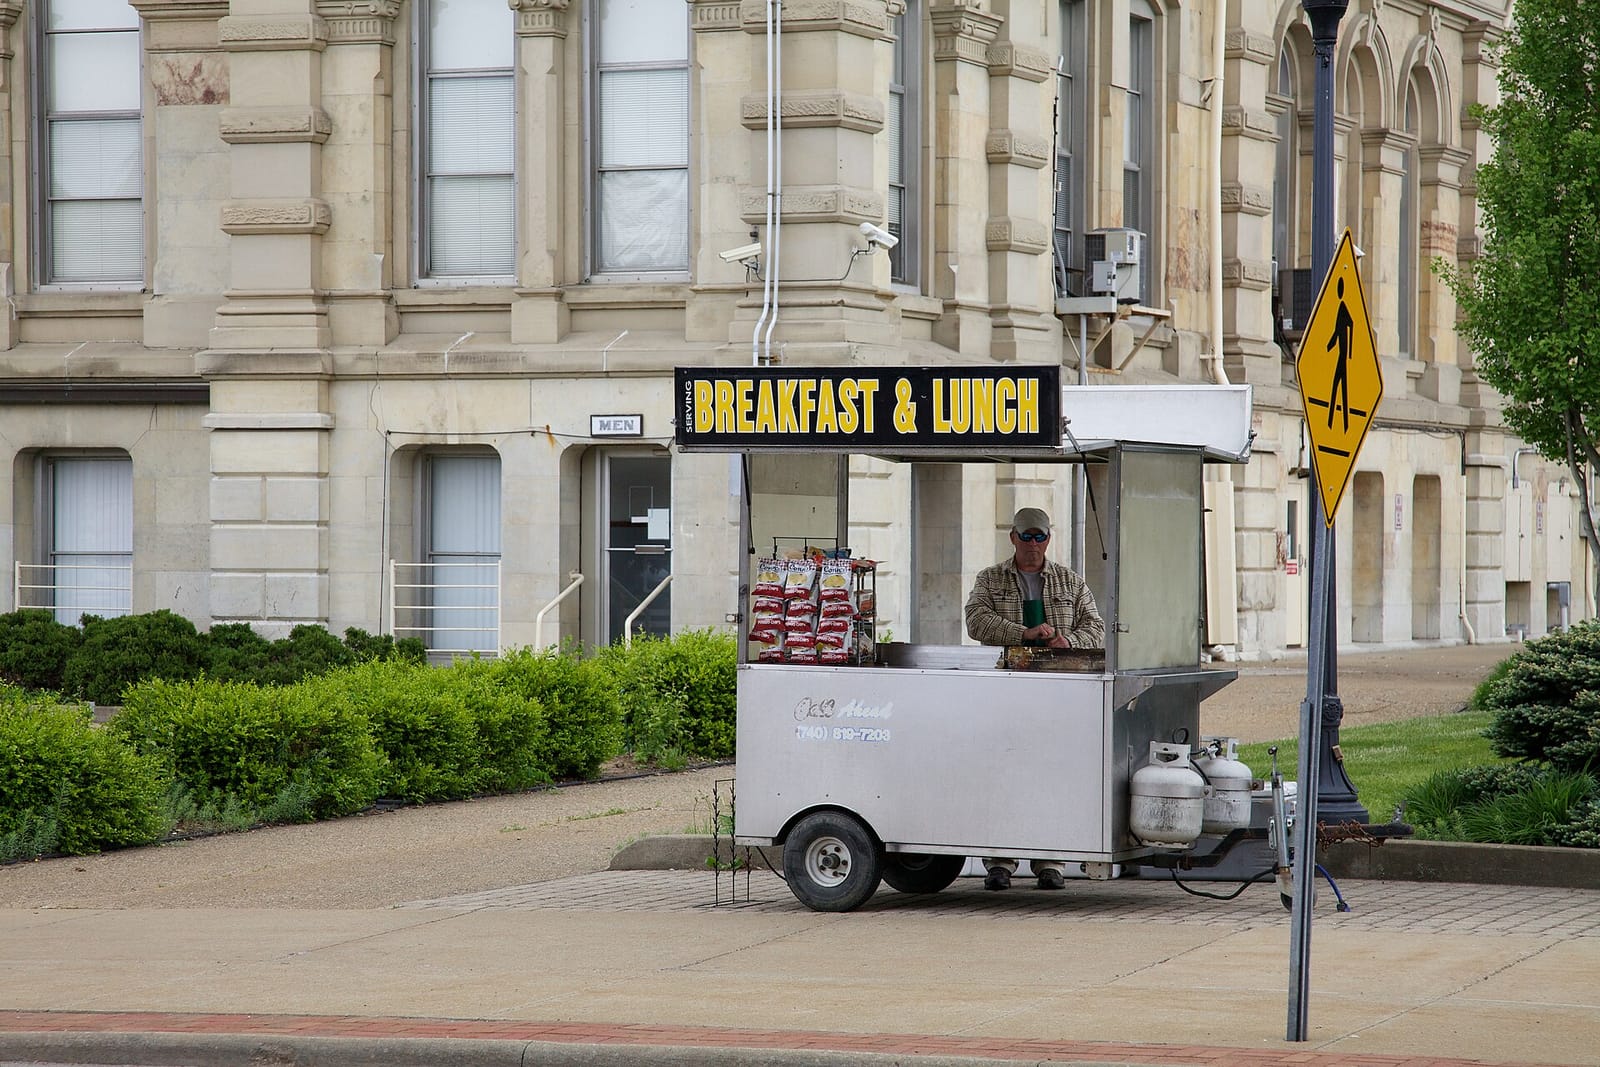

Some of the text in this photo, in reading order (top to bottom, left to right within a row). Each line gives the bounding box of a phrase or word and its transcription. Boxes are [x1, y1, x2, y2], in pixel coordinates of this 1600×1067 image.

[685, 380, 693, 433] SERVING
[694, 377, 1040, 434] BREAKFAST & LUNCH
[599, 420, 634, 431] MEN
[795, 725, 828, 740] (740)
